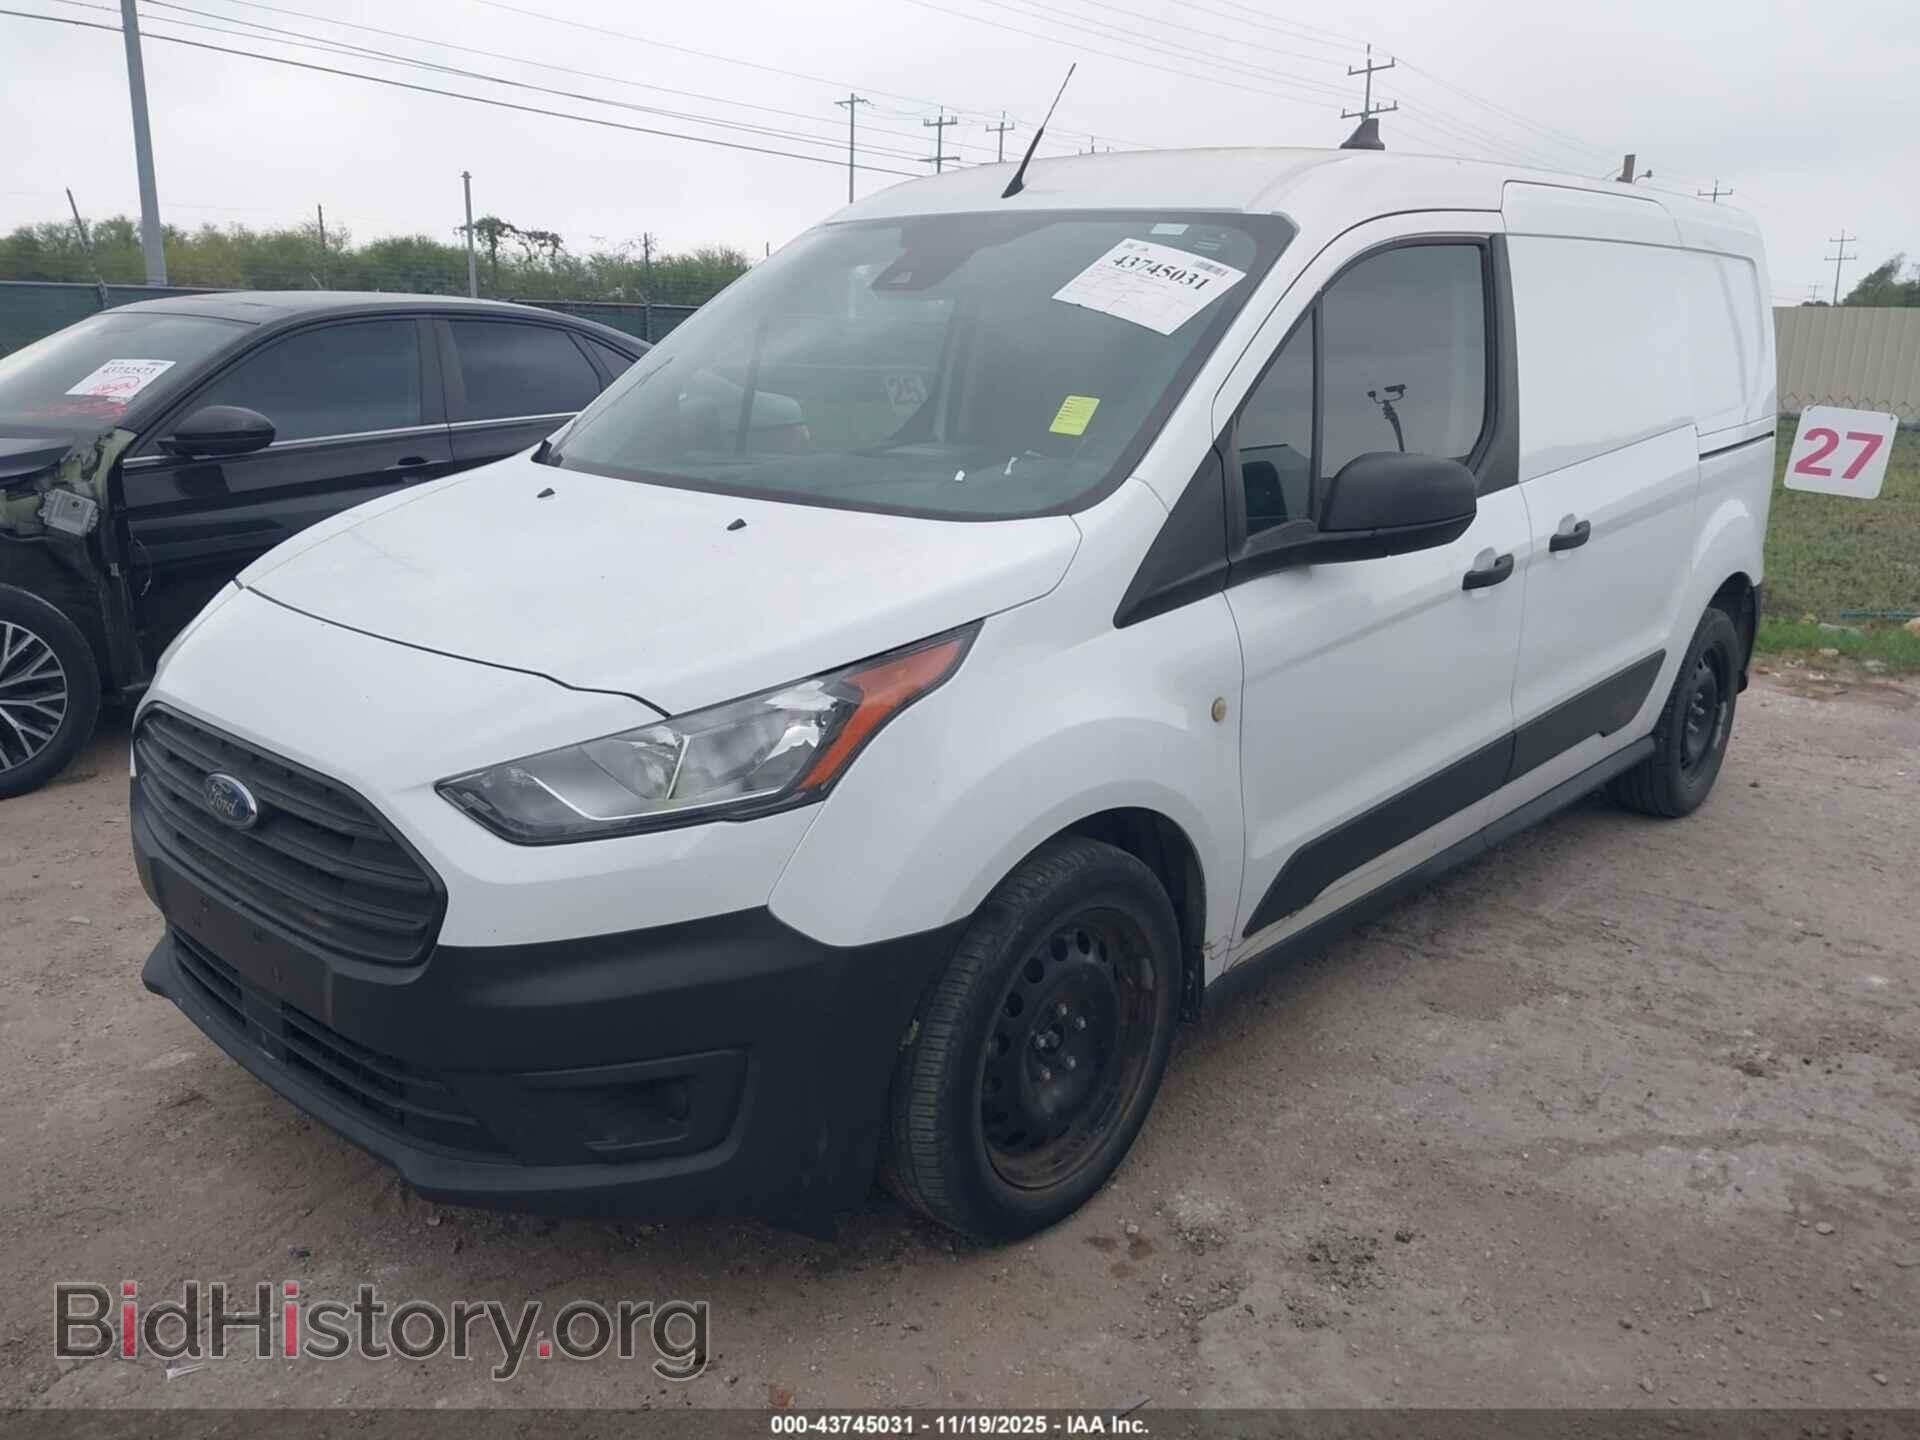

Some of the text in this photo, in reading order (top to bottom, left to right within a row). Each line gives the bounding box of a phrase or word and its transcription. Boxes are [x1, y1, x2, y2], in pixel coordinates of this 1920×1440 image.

[1113, 253, 1212, 291] 43745031
[1793, 427, 1885, 480] 27
[208, 782, 239, 818] Ford
